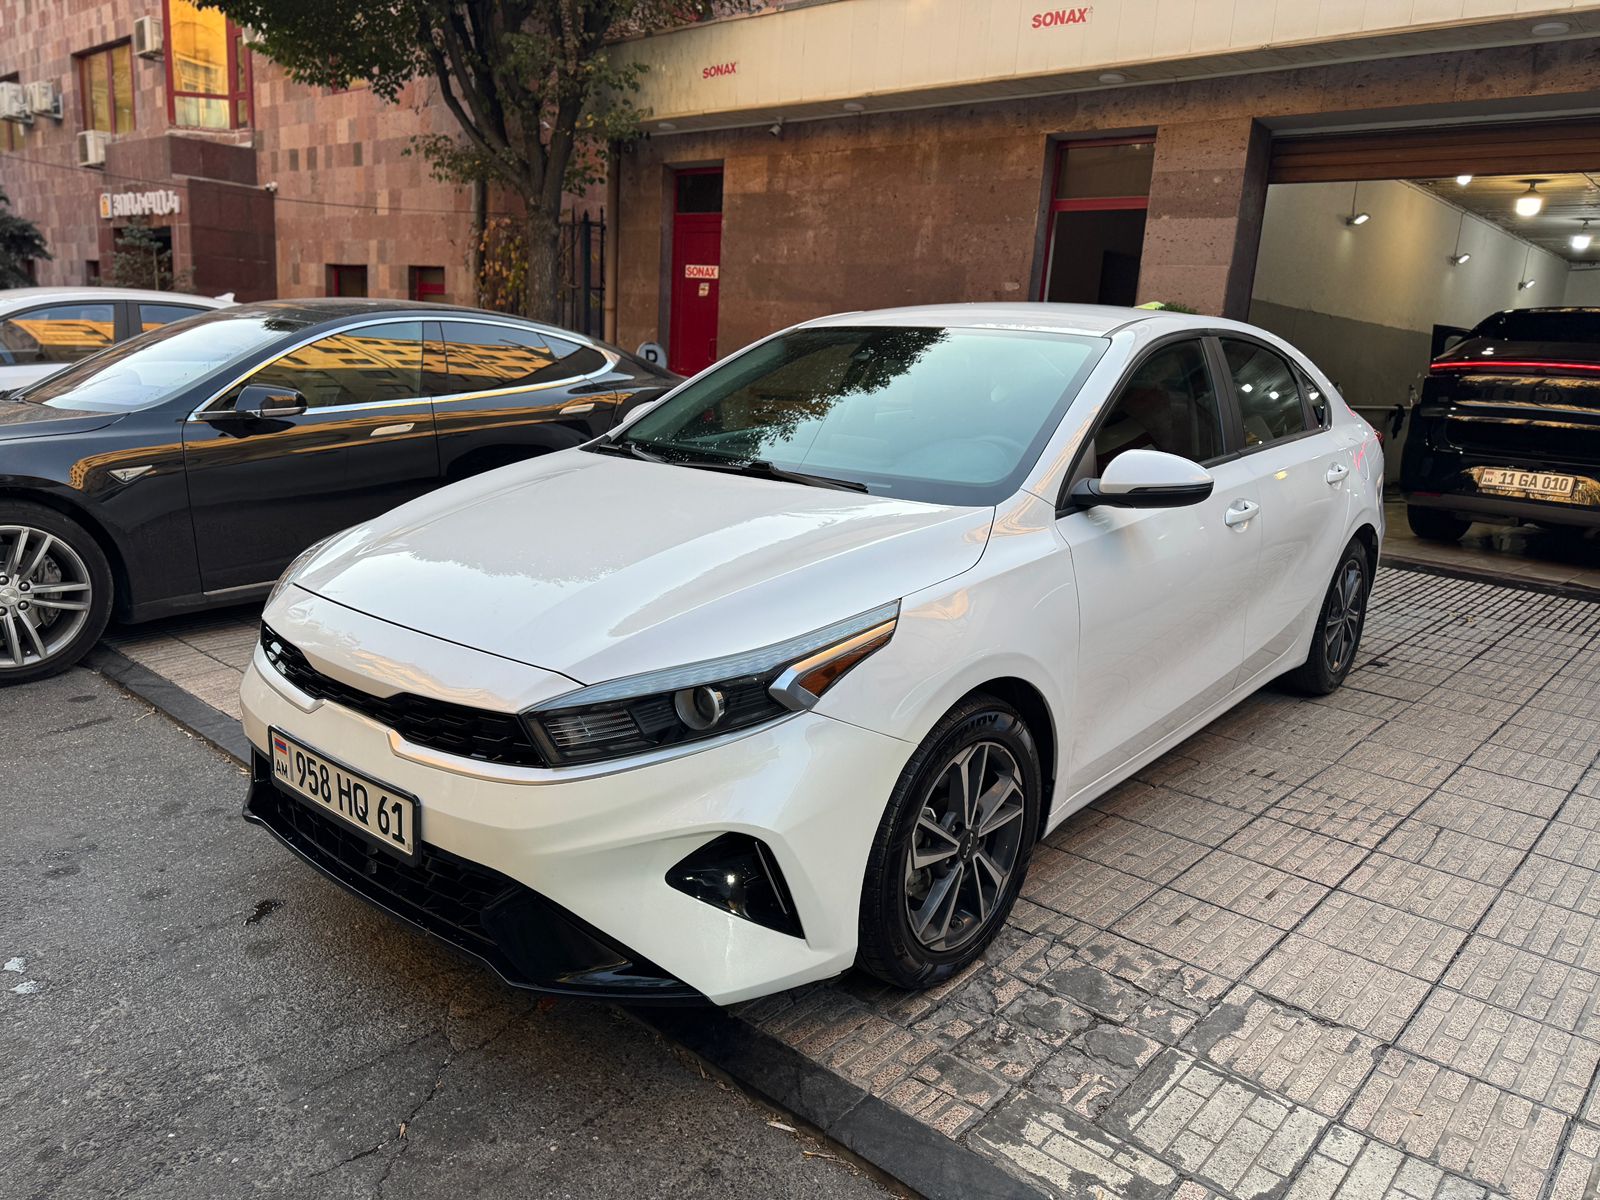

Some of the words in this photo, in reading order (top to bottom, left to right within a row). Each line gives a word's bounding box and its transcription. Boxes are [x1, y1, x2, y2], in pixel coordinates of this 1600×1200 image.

[1032, 7, 1088, 28] SONAX
[703, 61, 736, 79] SONAX
[687, 266, 715, 277] SONAX
[1498, 472, 1515, 485] 11
[1518, 474, 1537, 488] GA
[1543, 476, 1568, 491] 010
[276, 759, 288, 779] AM
[296, 751, 332, 804] 958
[336, 773, 369, 826] HQ
[377, 796, 405, 845] 61
